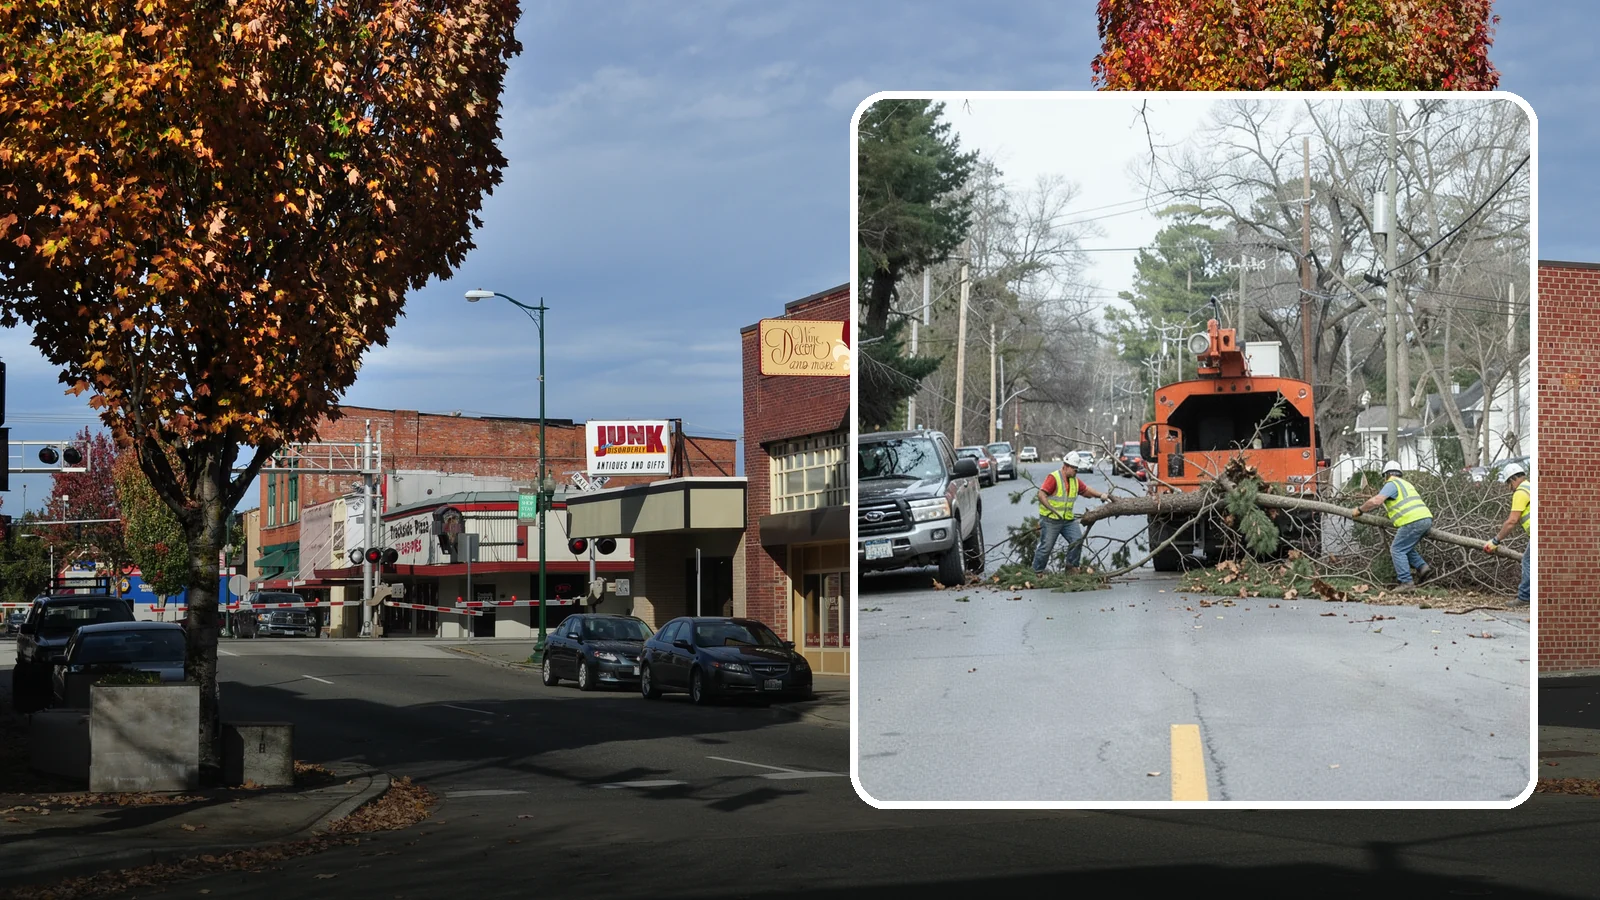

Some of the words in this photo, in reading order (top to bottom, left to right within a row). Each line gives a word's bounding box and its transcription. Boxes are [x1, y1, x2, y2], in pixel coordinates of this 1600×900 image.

[596, 425, 665, 457] JUNK
[607, 446, 645, 454] DISORDERLY
[597, 461, 628, 470] ANTIQUES
[631, 461, 644, 470] AND
[647, 460, 665, 470] GIFTS
[352, 498, 365, 511] CRO
[415, 519, 429, 535] Pizza
